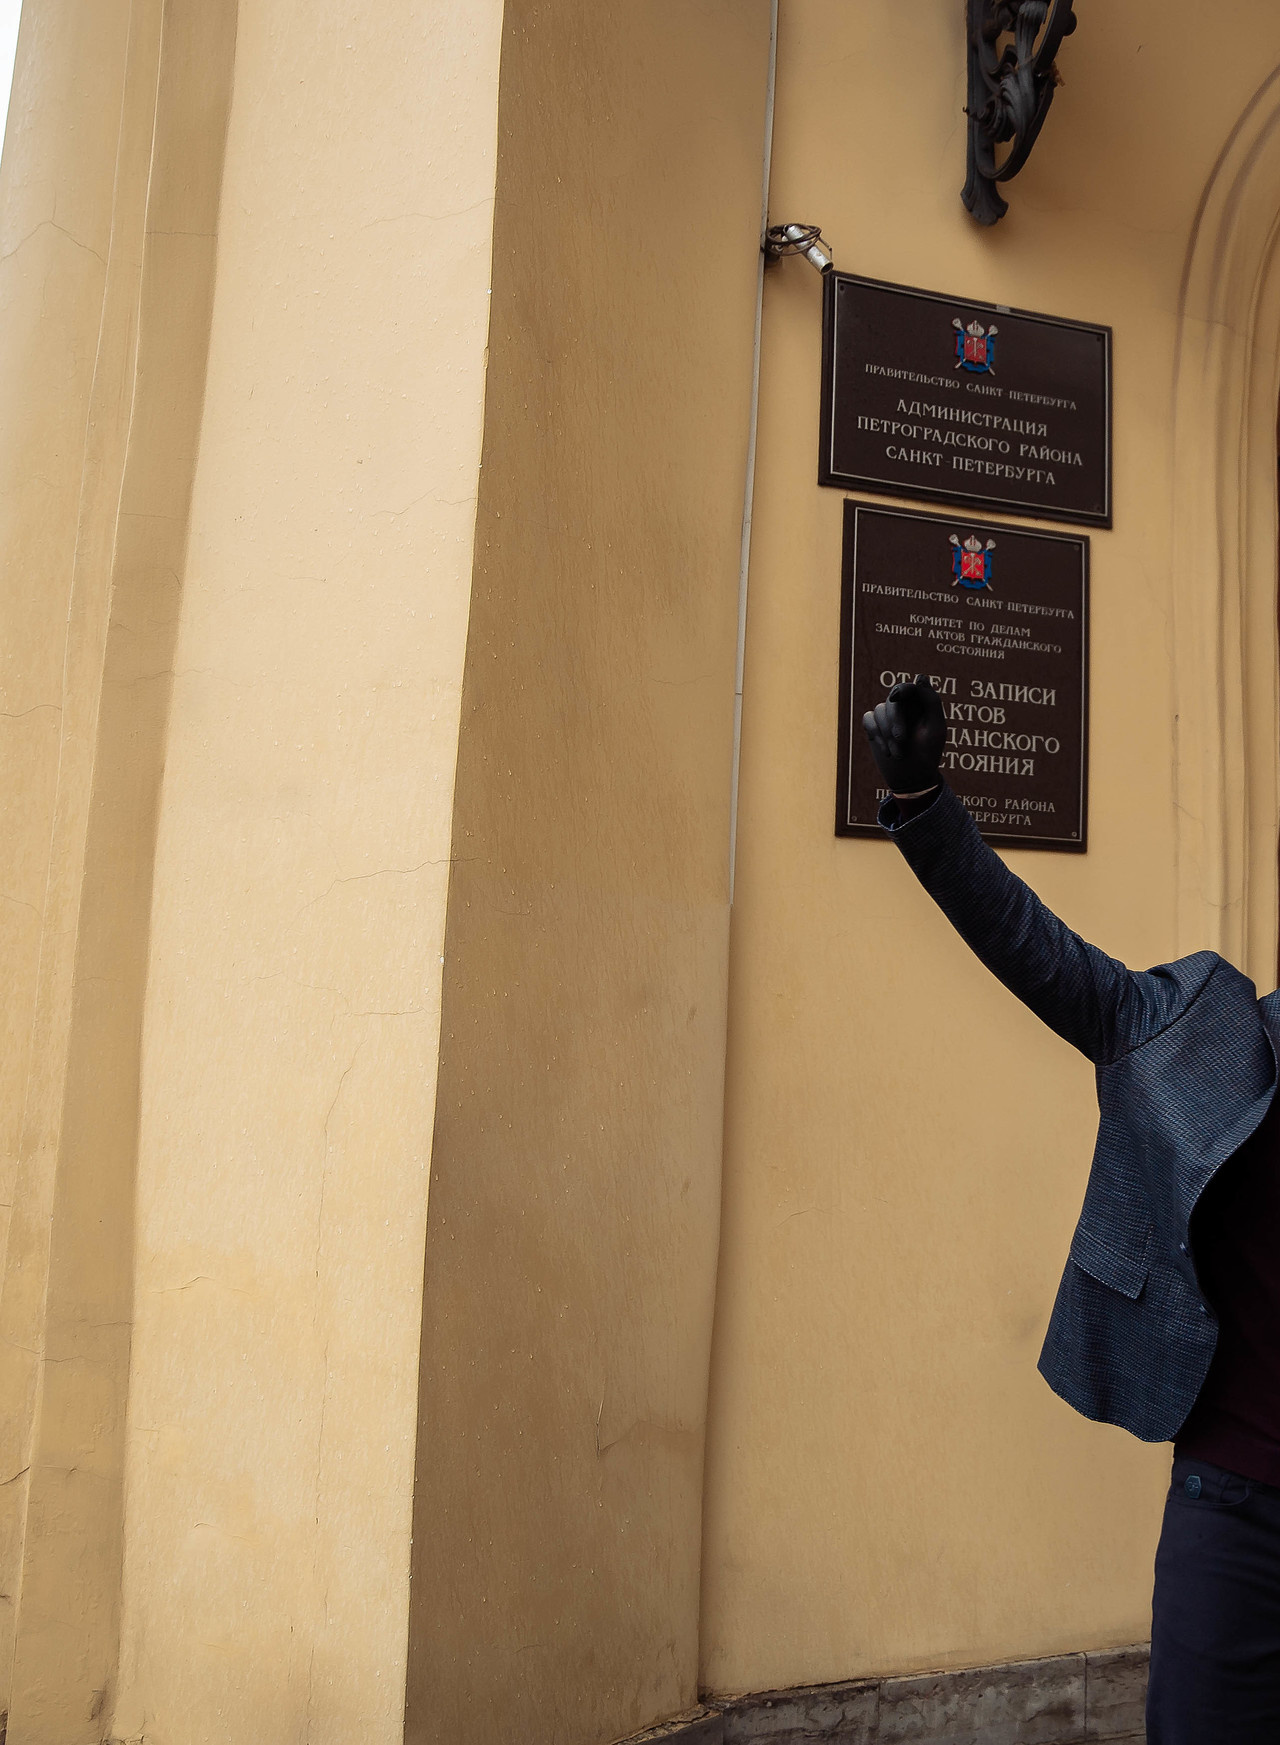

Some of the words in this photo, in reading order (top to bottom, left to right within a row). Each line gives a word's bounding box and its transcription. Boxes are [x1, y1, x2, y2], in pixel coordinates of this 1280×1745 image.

[865, 363, 960, 389] ПРАВИТЕЛЬСТВО
[896, 399, 1048, 437] АДМИНИСТРАЦИЯ
[857, 415, 1010, 454] ПЕТРОГРАДСКОГО
[1019, 443, 1083, 467] РАЙОНА
[861, 582, 959, 604] ПРАВИТЕЛЬСТВО
[875, 622, 922, 638] ЗАПИСИ
[928, 629, 966, 643] АКТОВ
[970, 633, 1062, 654] ГРАЖДАНСКОГО
[909, 613, 963, 630] КОМИТЕТ
[969, 621, 985, 632] ПО
[990, 623, 1031, 638] ДЕЛАМ
[936, 642, 1005, 660] СОСТОЯНИЯ
[970, 680, 1057, 706] ЗАПИСИ
[945, 727, 1060, 754] ДАНСКОГО
[938, 752, 1035, 776] ТОЯНИЯ
[1005, 798, 1056, 813] РАЙОНА
